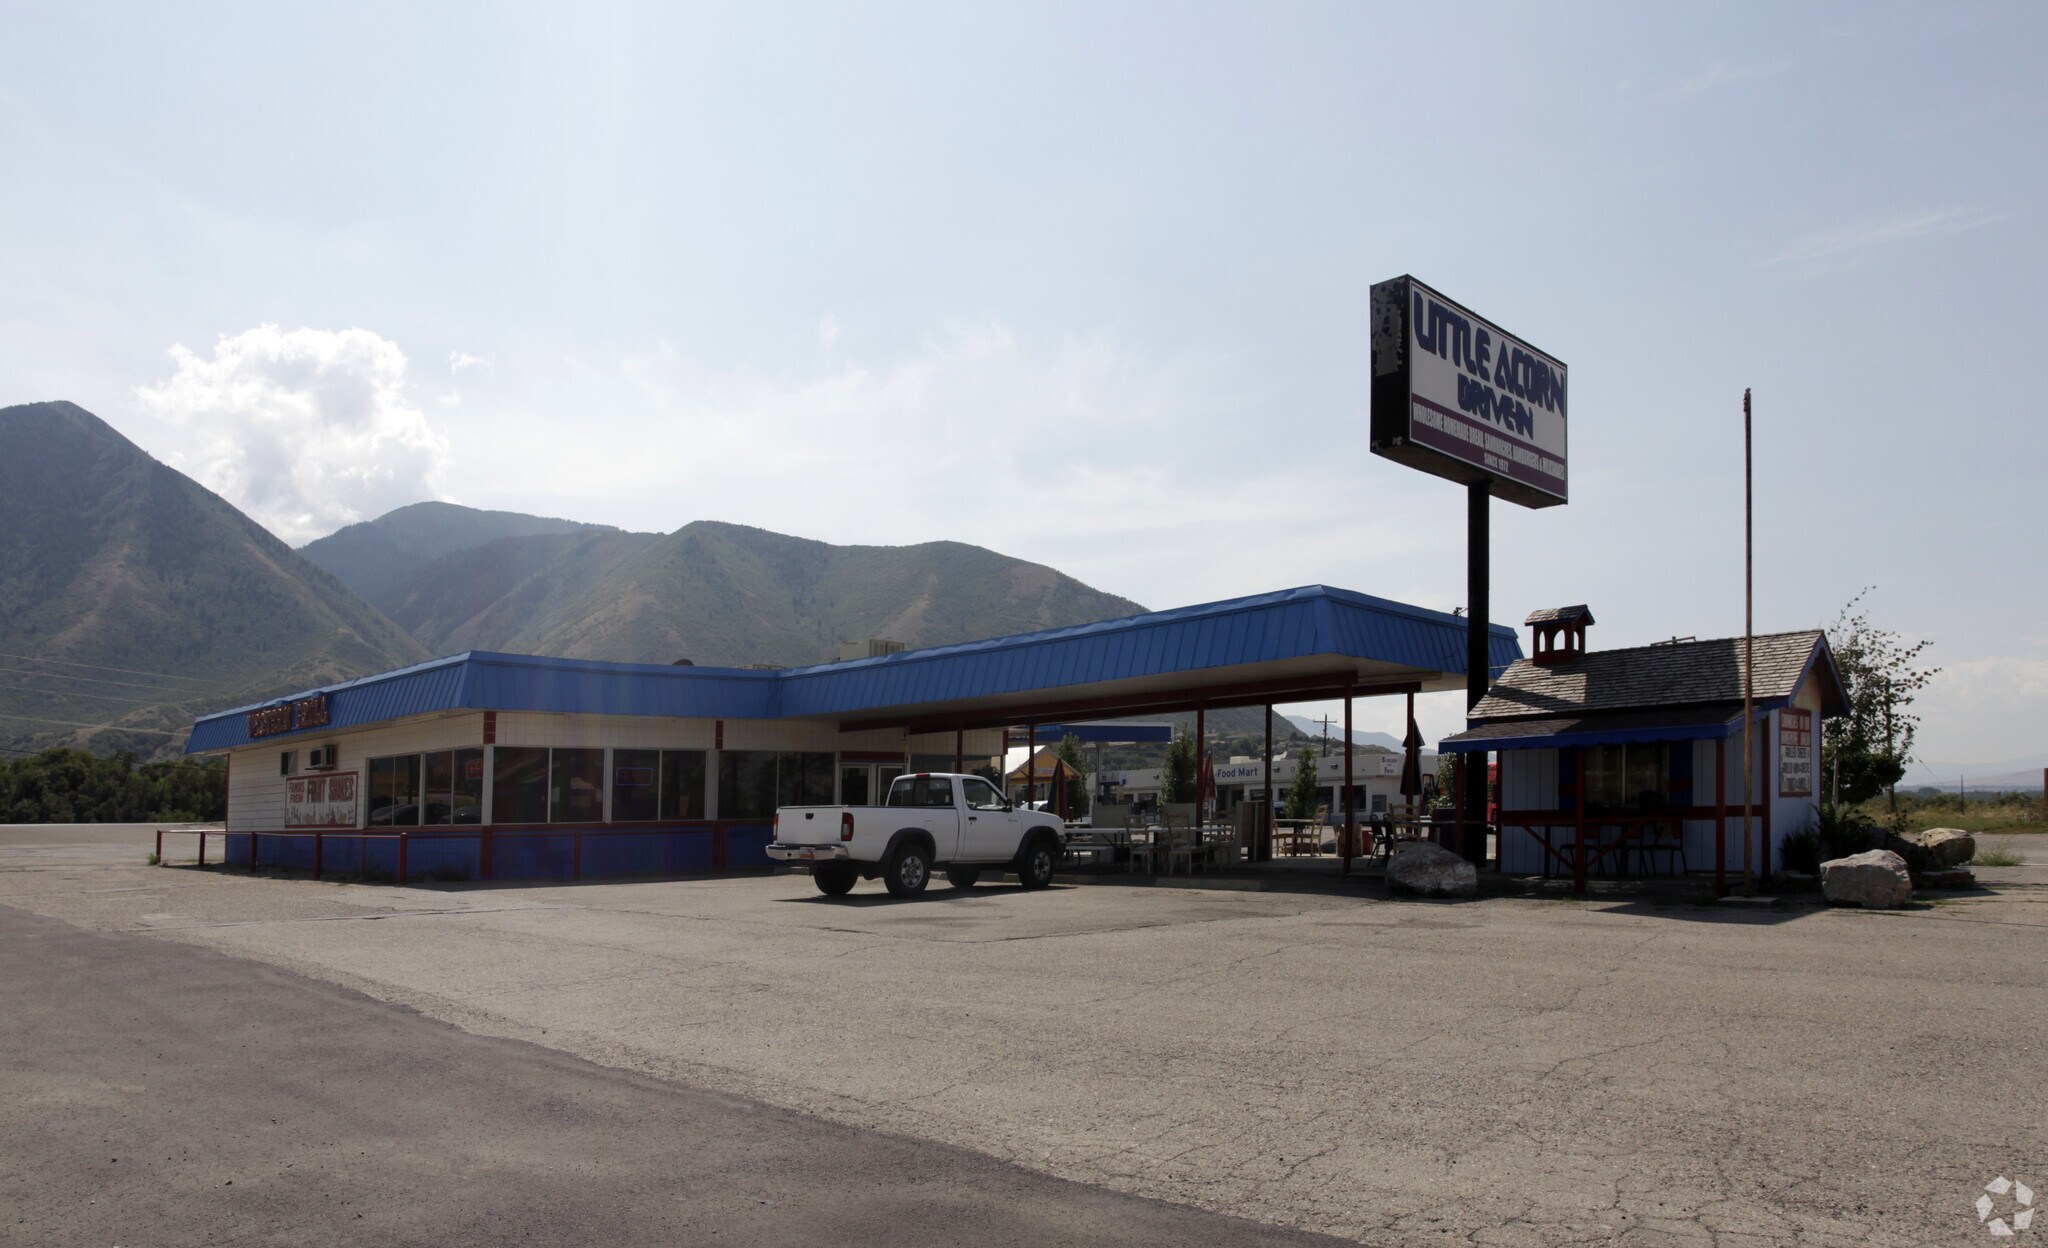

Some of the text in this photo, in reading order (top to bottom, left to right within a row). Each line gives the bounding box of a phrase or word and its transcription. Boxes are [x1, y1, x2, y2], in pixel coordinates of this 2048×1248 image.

[1414, 290, 1564, 419] LITTLE ACORN
[1485, 452, 1509, 473] SINCE 1972
[1217, 766, 1257, 778] Food Mart
[306, 776, 354, 805] FRUIT SHAKES
